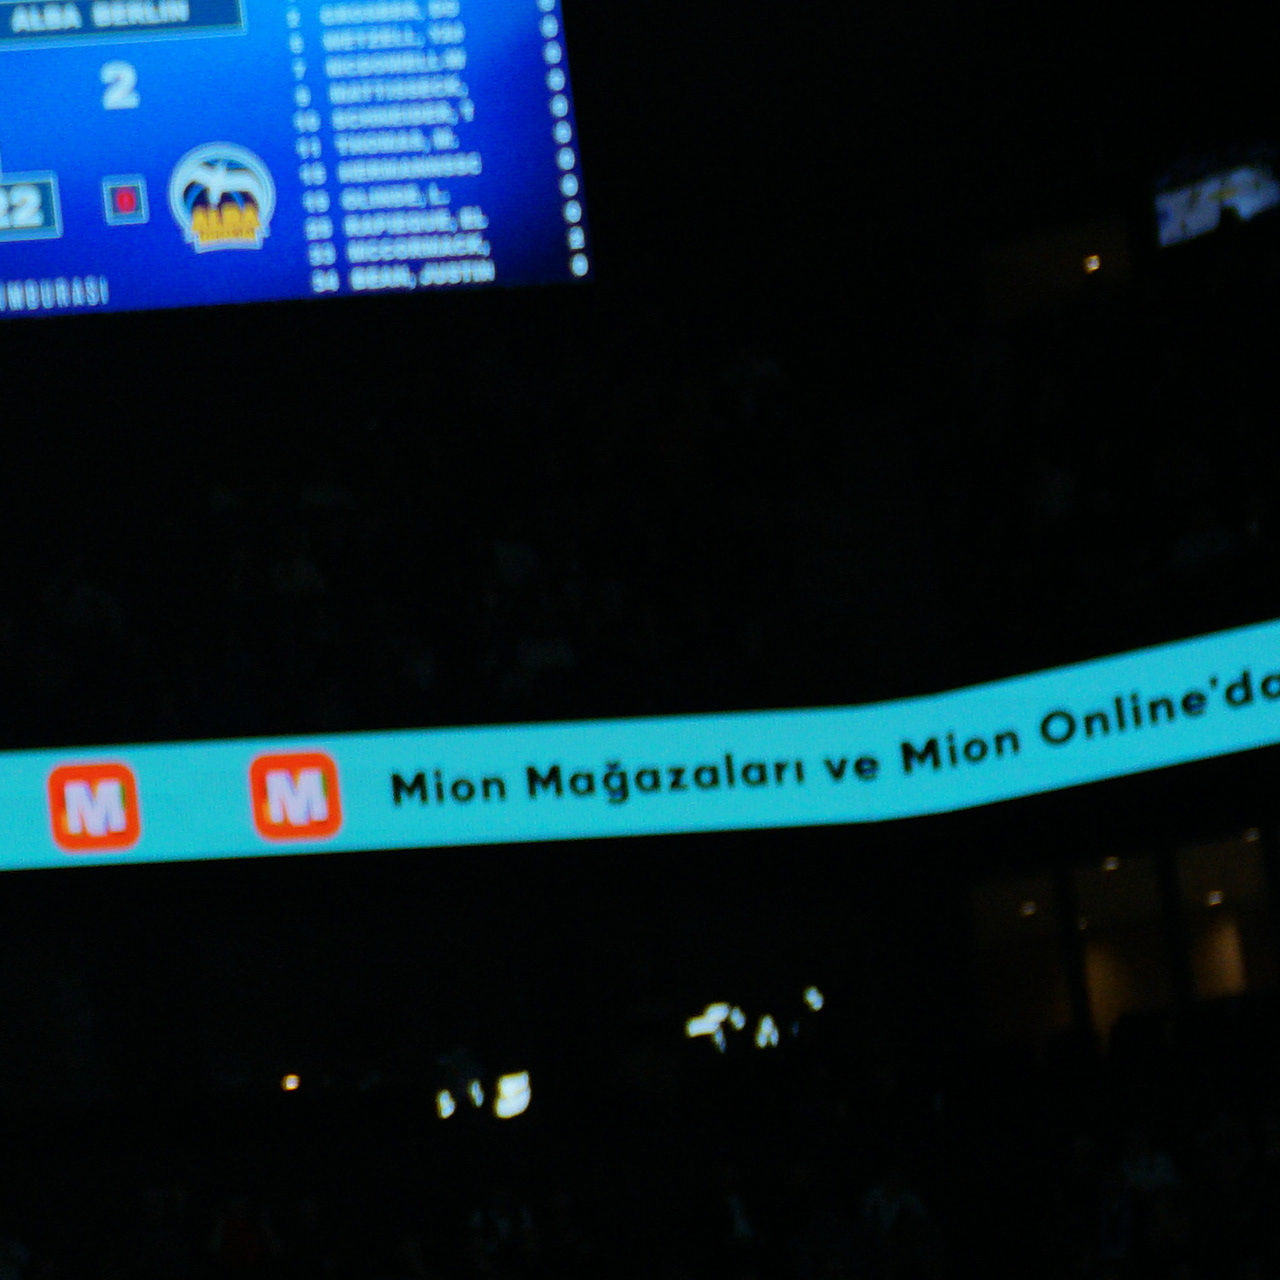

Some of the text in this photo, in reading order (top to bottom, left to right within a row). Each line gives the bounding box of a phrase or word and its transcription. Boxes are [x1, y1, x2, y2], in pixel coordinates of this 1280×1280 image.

[100, 59, 140, 110] 2
[389, 768, 509, 807] Mion
[525, 752, 806, 804] Mağazaları
[823, 754, 880, 782] ve
[900, 727, 1021, 777] Mion
